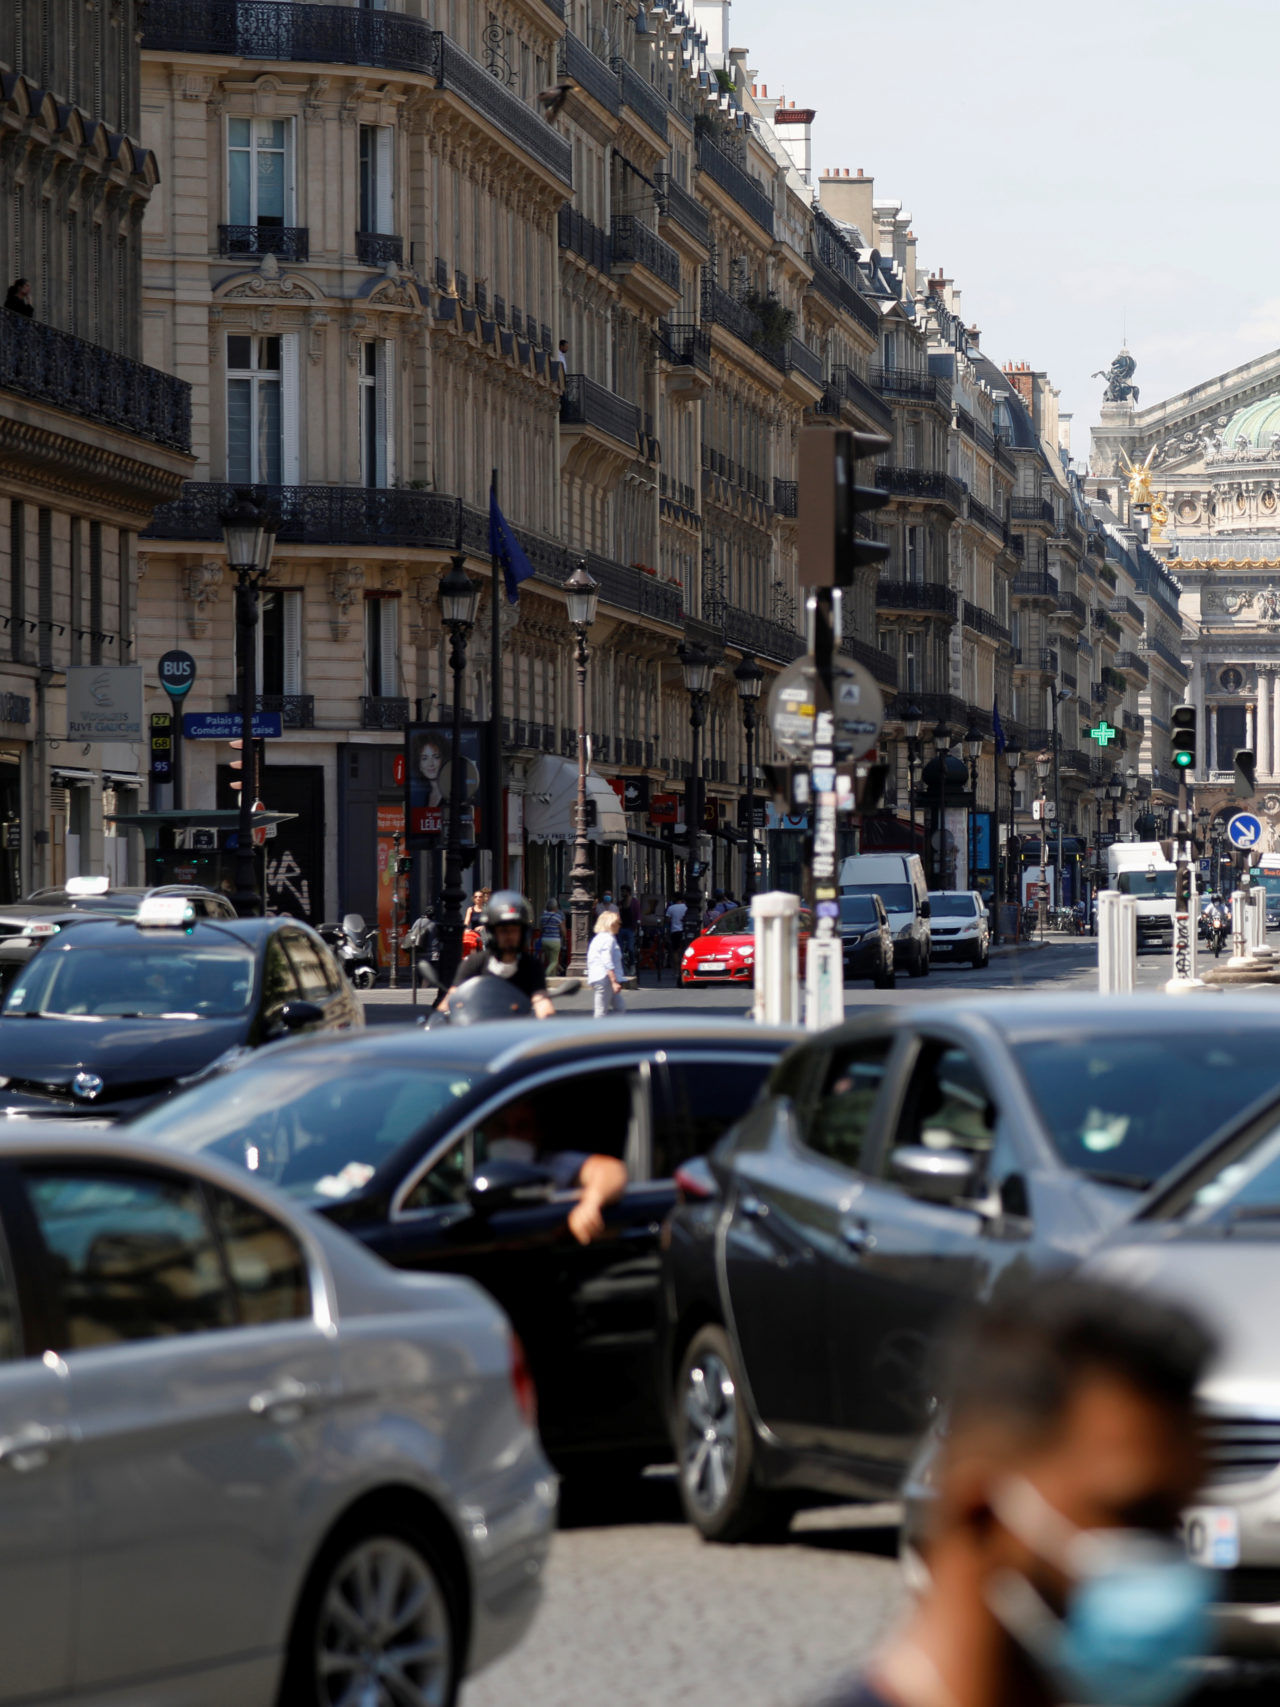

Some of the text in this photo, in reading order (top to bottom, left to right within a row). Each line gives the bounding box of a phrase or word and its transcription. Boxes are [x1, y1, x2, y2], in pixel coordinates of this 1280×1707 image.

[163, 661, 191, 675] BUS
[154, 716, 167, 725] 27
[205, 716, 232, 725] Palais
[190, 726, 230, 735] Comédie
[154, 740, 167, 748] 68
[154, 762, 168, 771] 95
